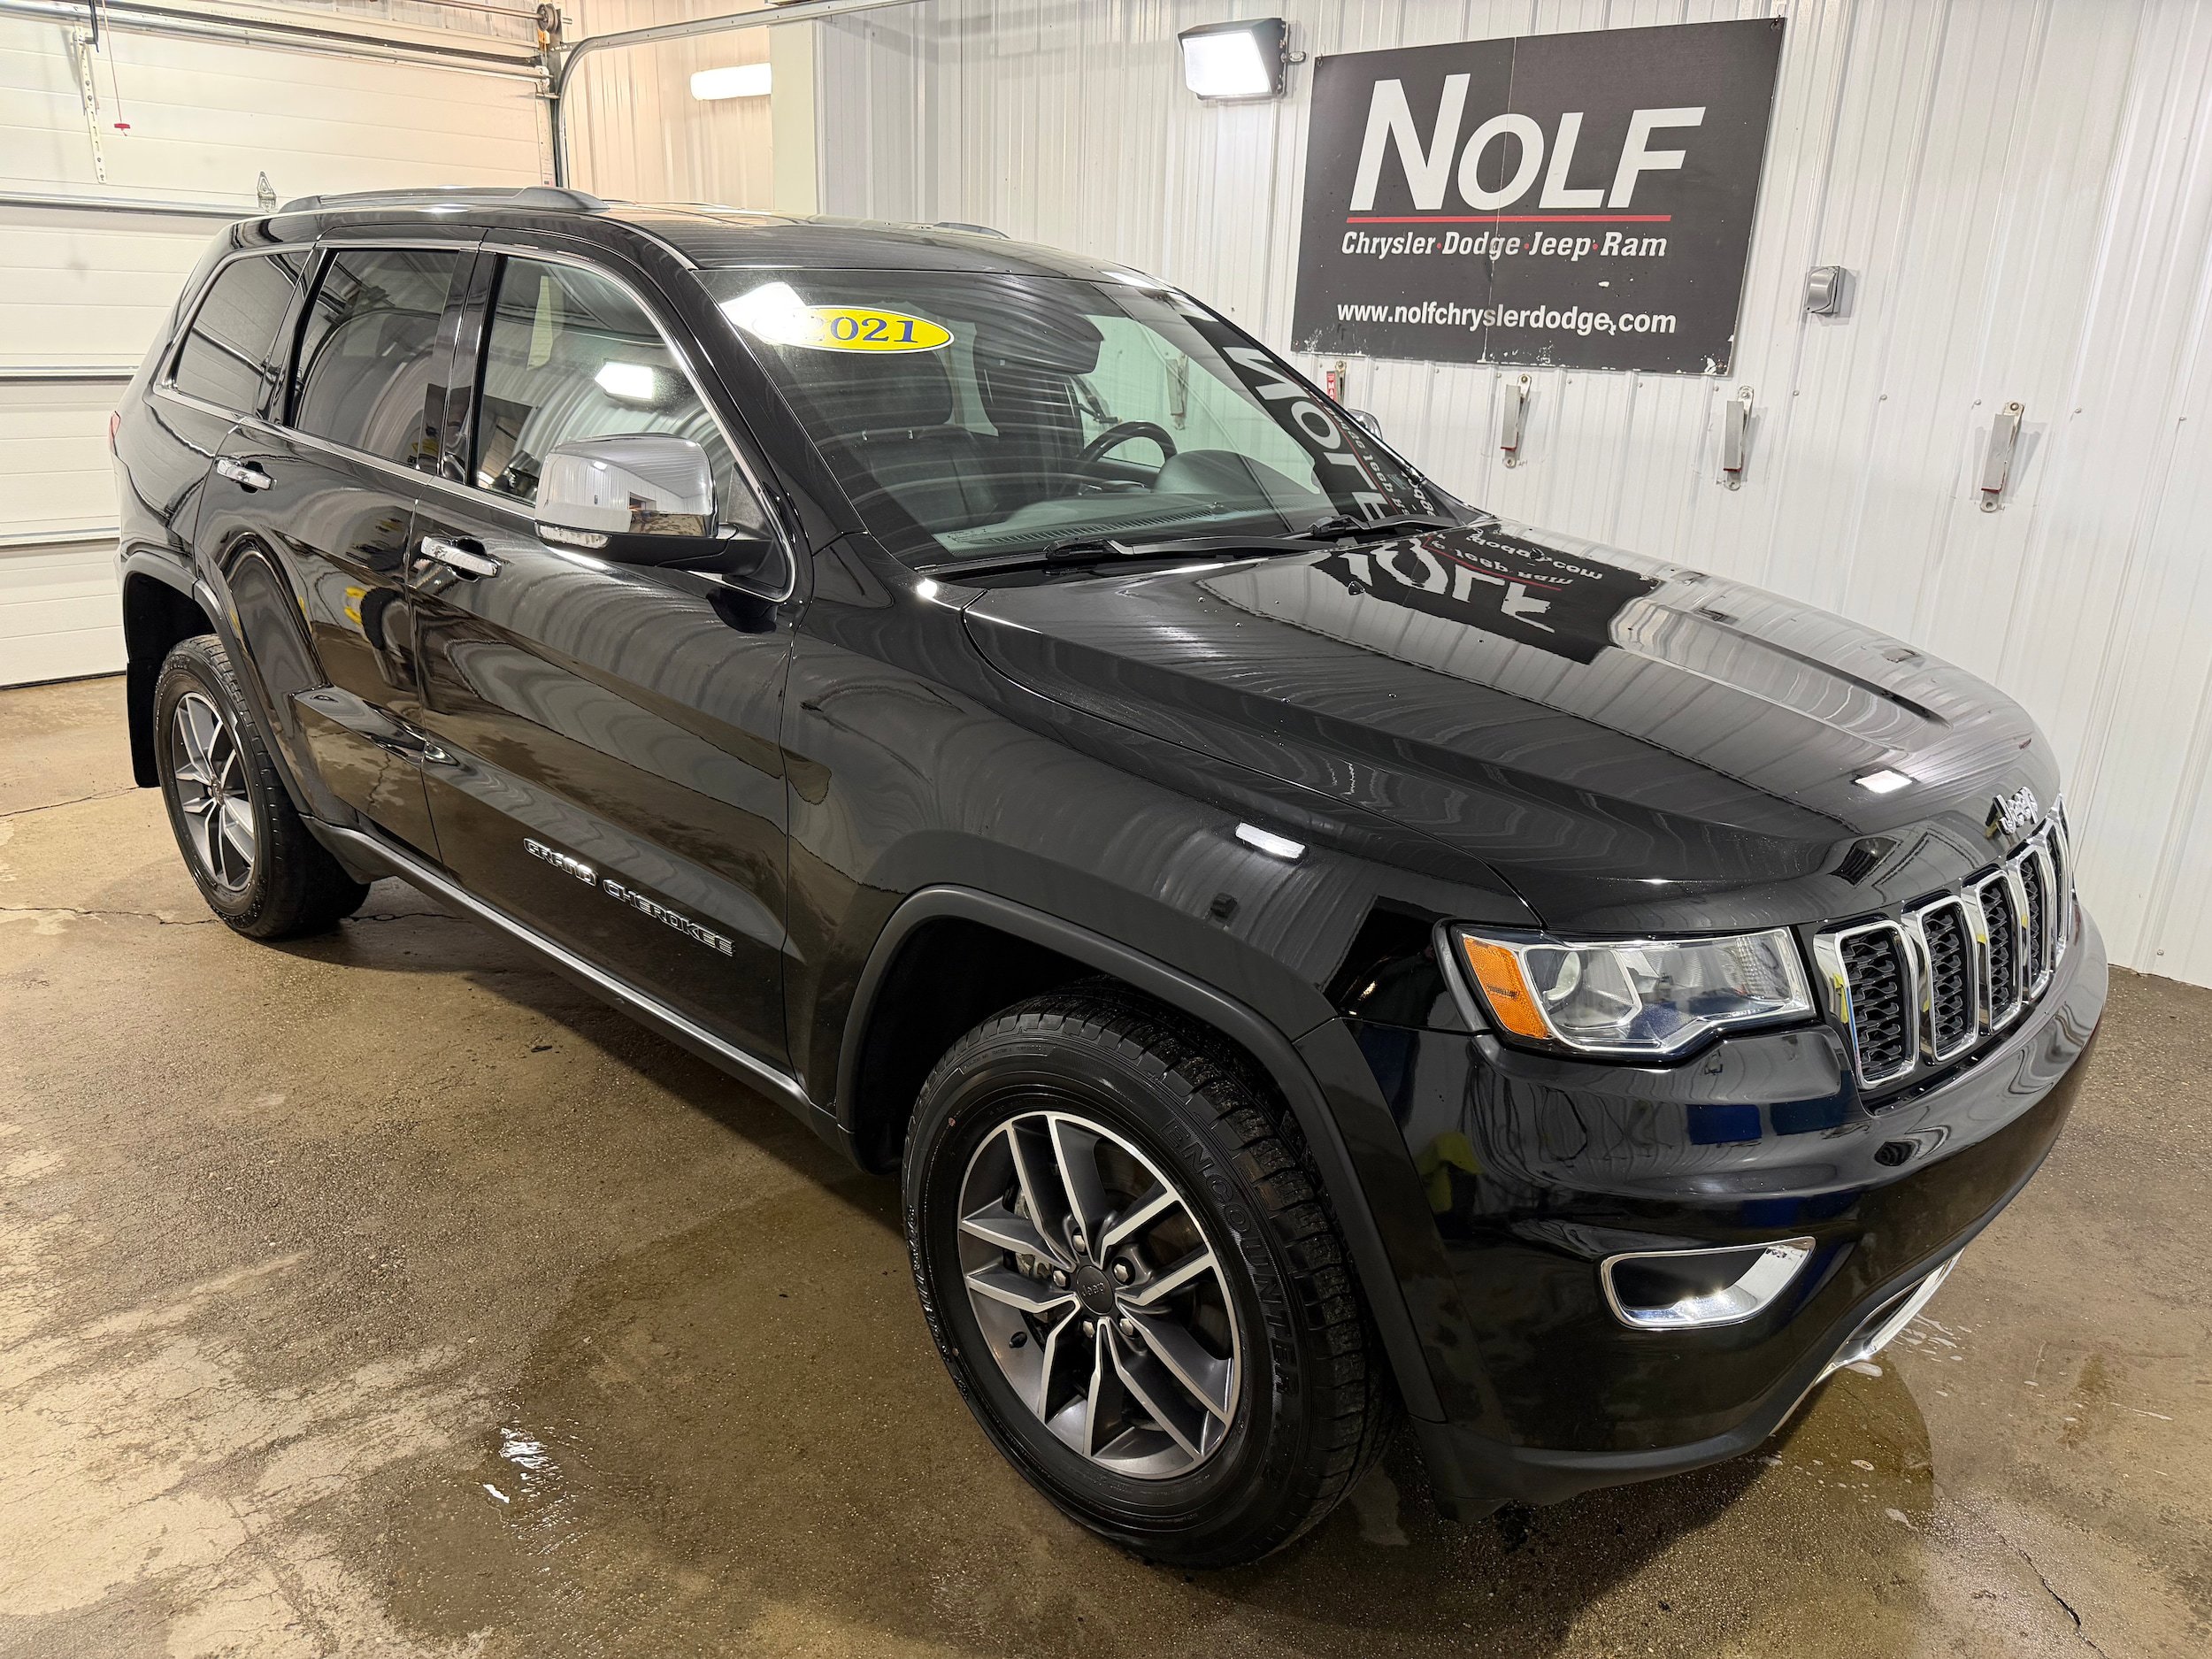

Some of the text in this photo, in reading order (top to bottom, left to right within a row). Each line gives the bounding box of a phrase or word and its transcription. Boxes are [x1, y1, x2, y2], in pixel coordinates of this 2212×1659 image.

[1349, 73, 1706, 211] NOLF
[1341, 231, 1667, 261] Chrysler Dodge Jeep Ram
[803, 316, 918, 343] 021
[1337, 302, 1677, 334] www.nolfchryslerdodge.com
[524, 838, 735, 956] GRAND CHEROKEE
